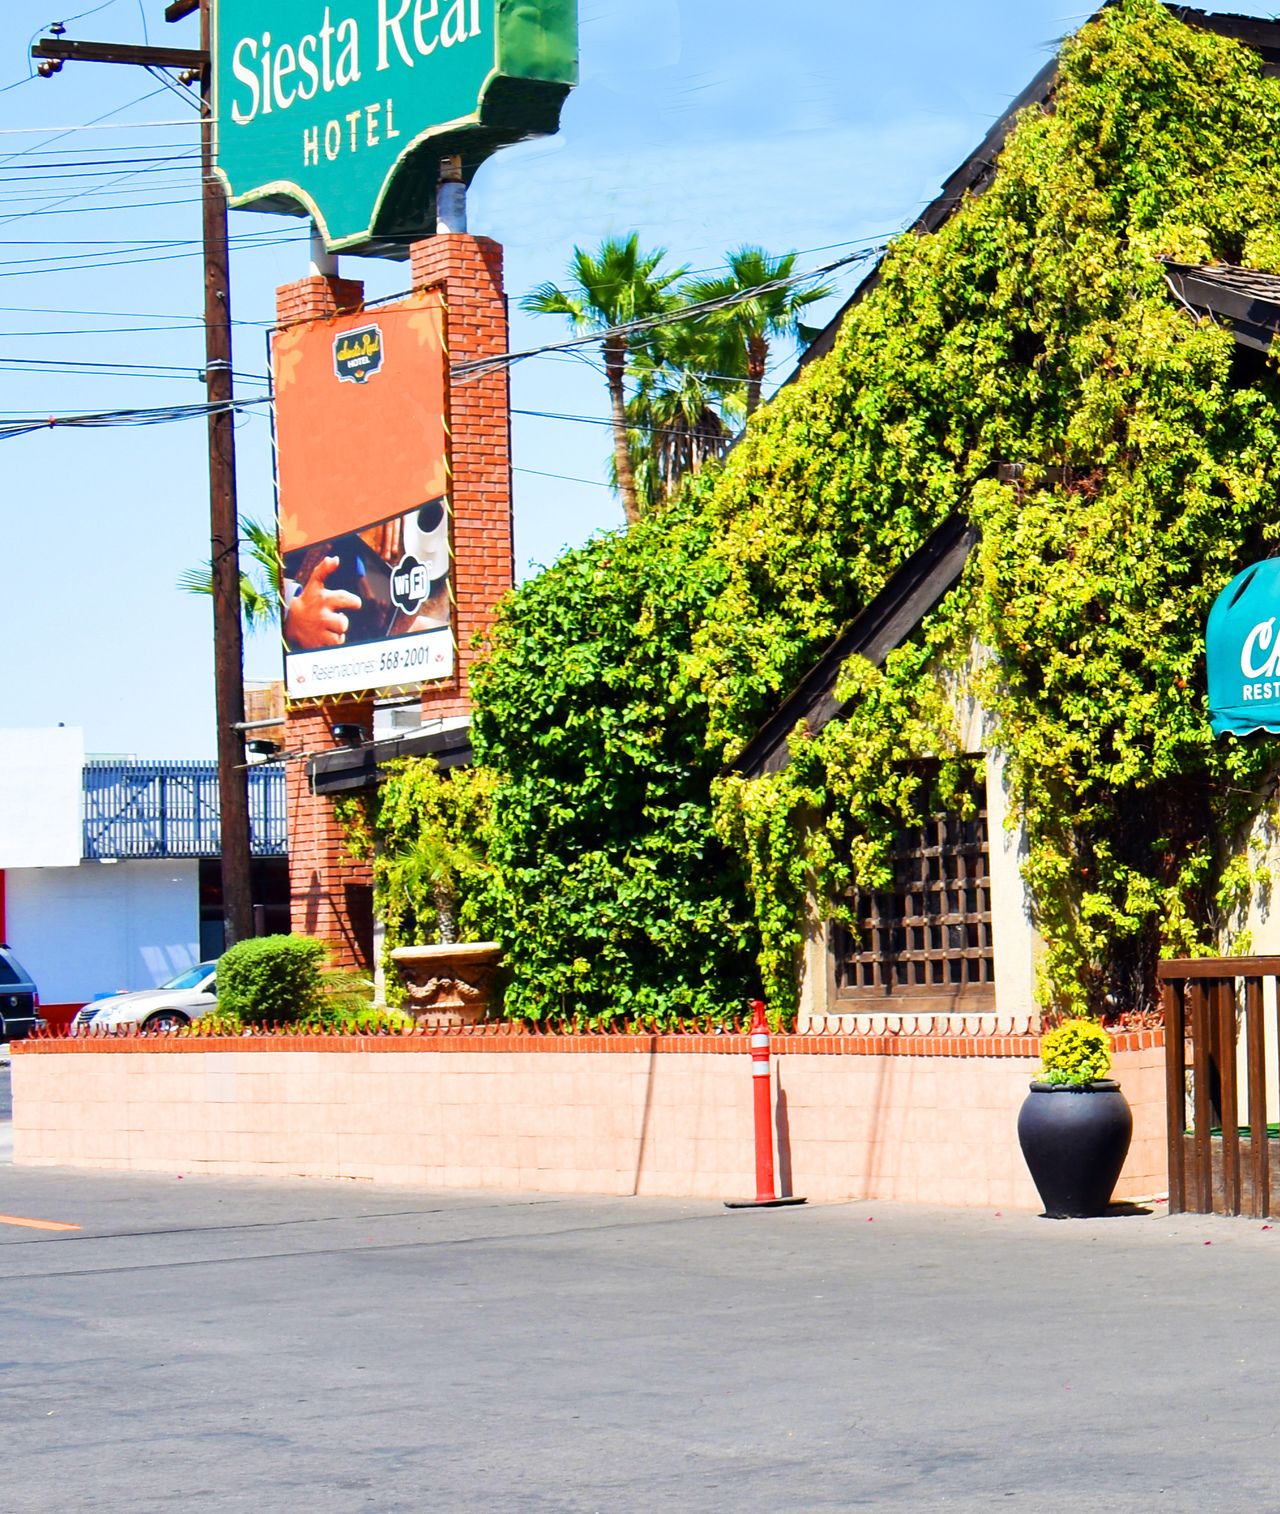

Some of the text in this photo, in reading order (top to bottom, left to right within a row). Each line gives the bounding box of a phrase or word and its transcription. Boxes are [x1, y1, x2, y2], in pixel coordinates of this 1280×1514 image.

[231, 6, 361, 126] Siesta
[303, 98, 400, 166] HOTEL
[347, 356, 371, 369] HOTEL
[379, 646, 429, 671] 568-2001
